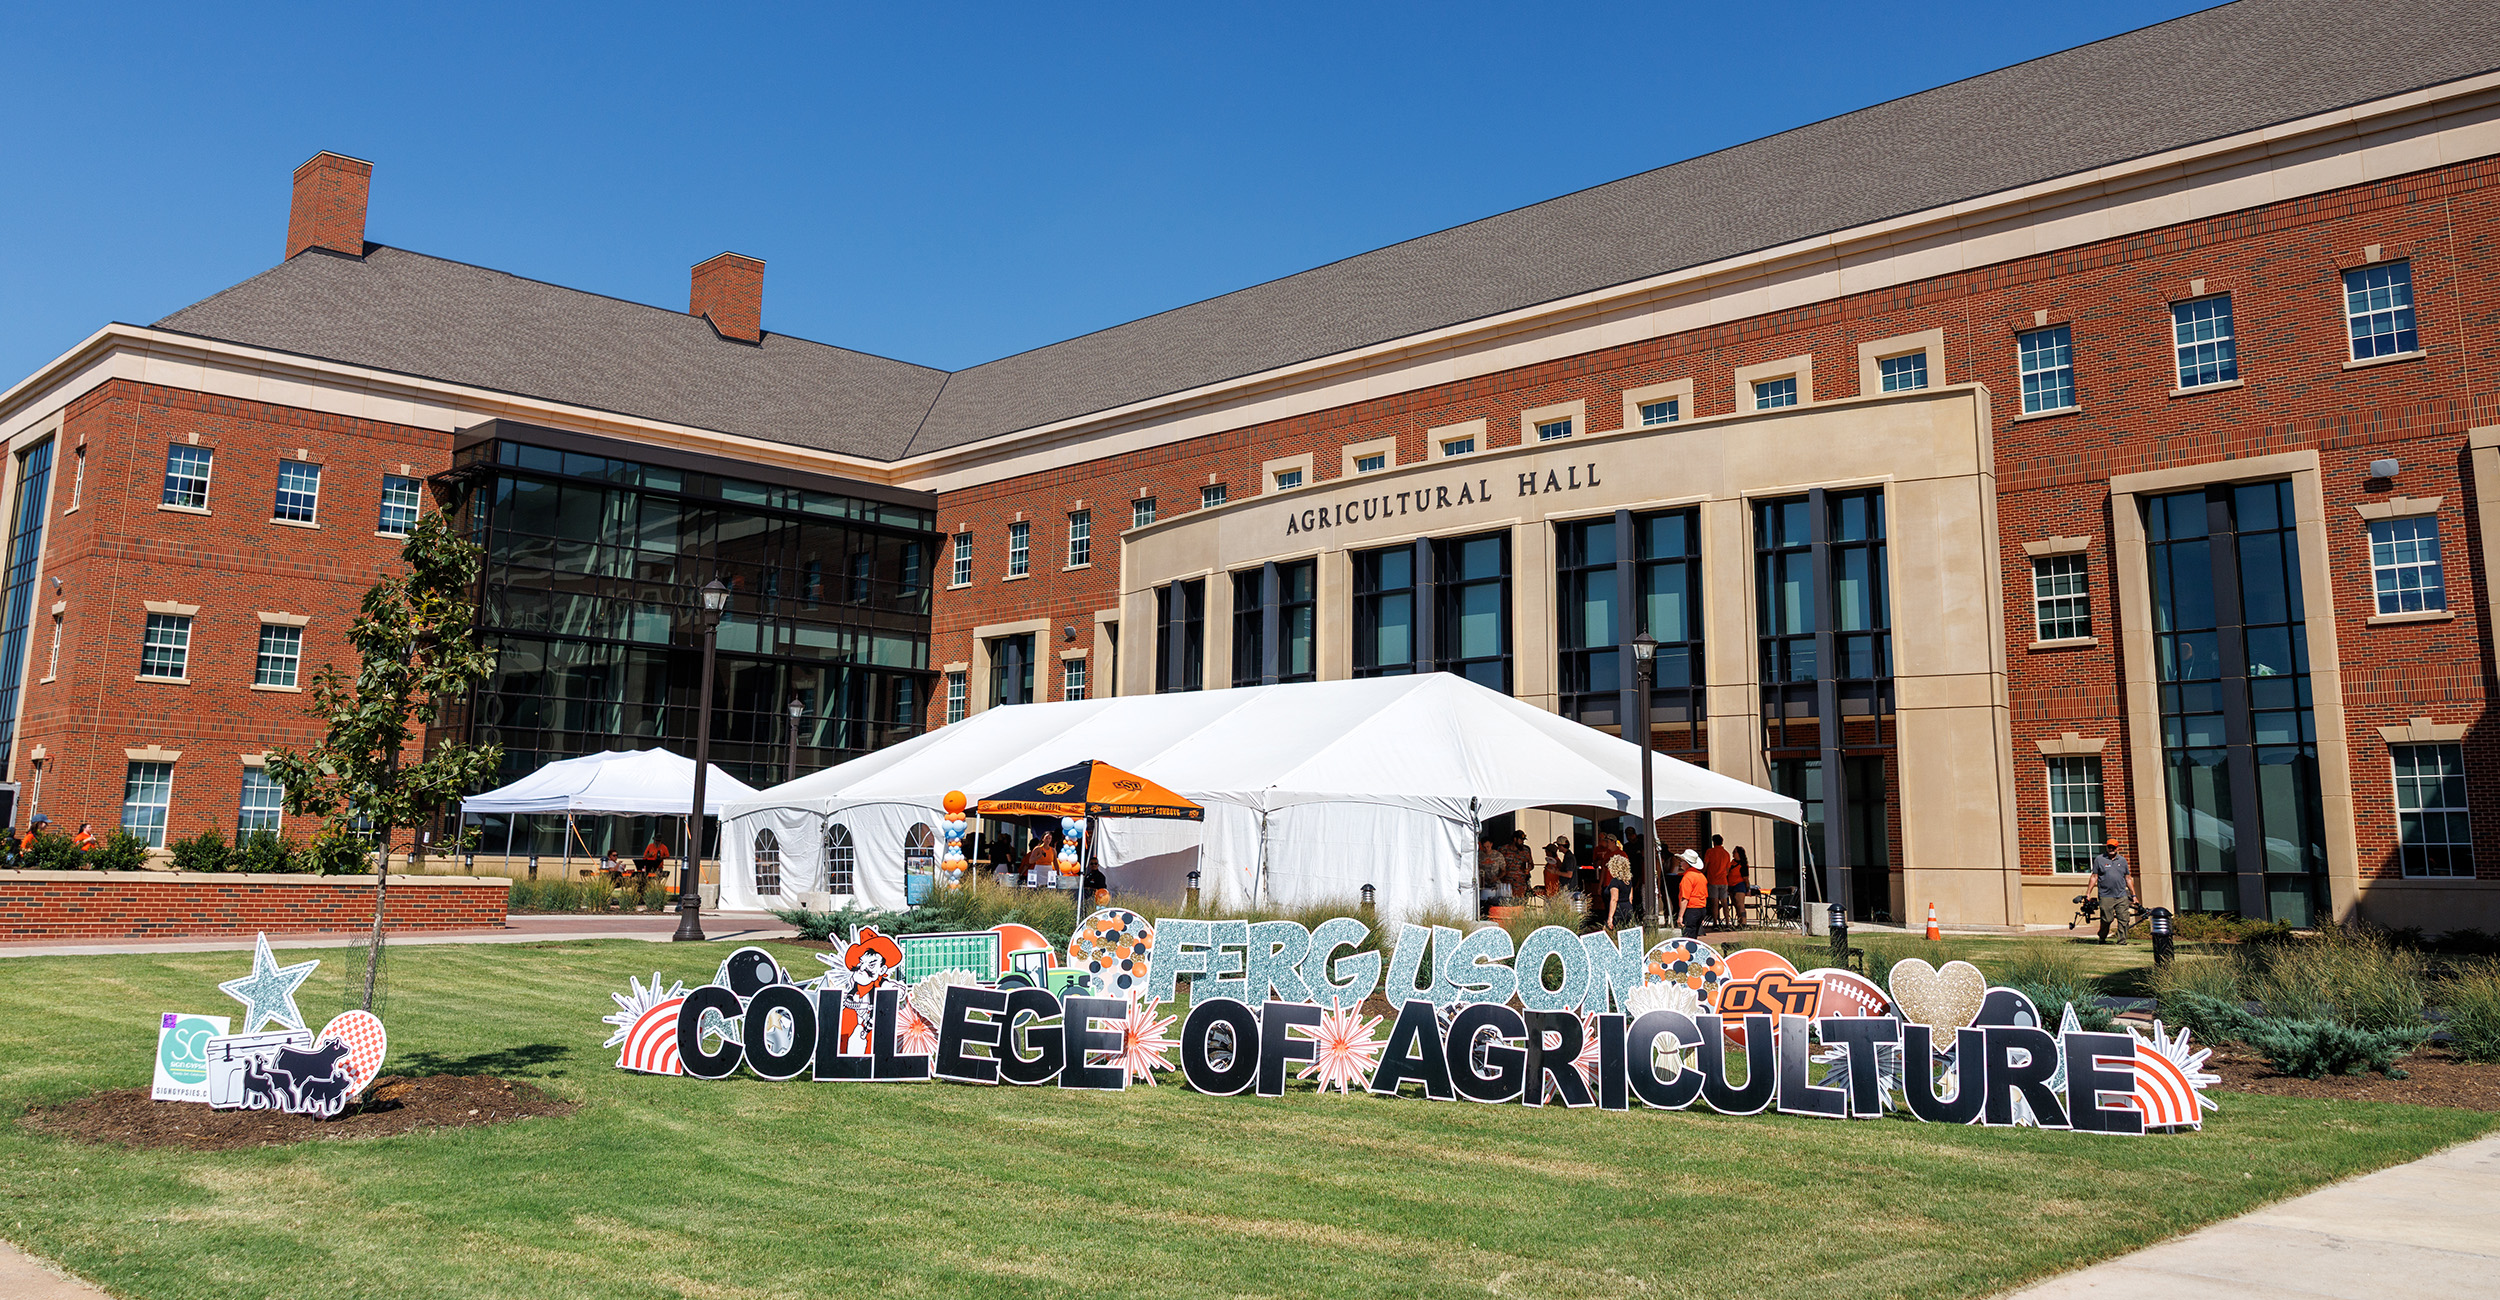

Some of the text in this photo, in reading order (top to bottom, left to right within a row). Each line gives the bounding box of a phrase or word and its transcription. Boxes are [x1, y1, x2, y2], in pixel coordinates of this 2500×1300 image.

[1286, 463, 1602, 536] AGRICULTURAL HALL
[1109, 805, 1138, 814] OKLAHOMA
[1720, 972, 1818, 1029] OSU
[678, 983, 2146, 1135] COLLEGE OF AGRICULTURE
[156, 1087, 207, 1098] SIGNGYPSIES.C
